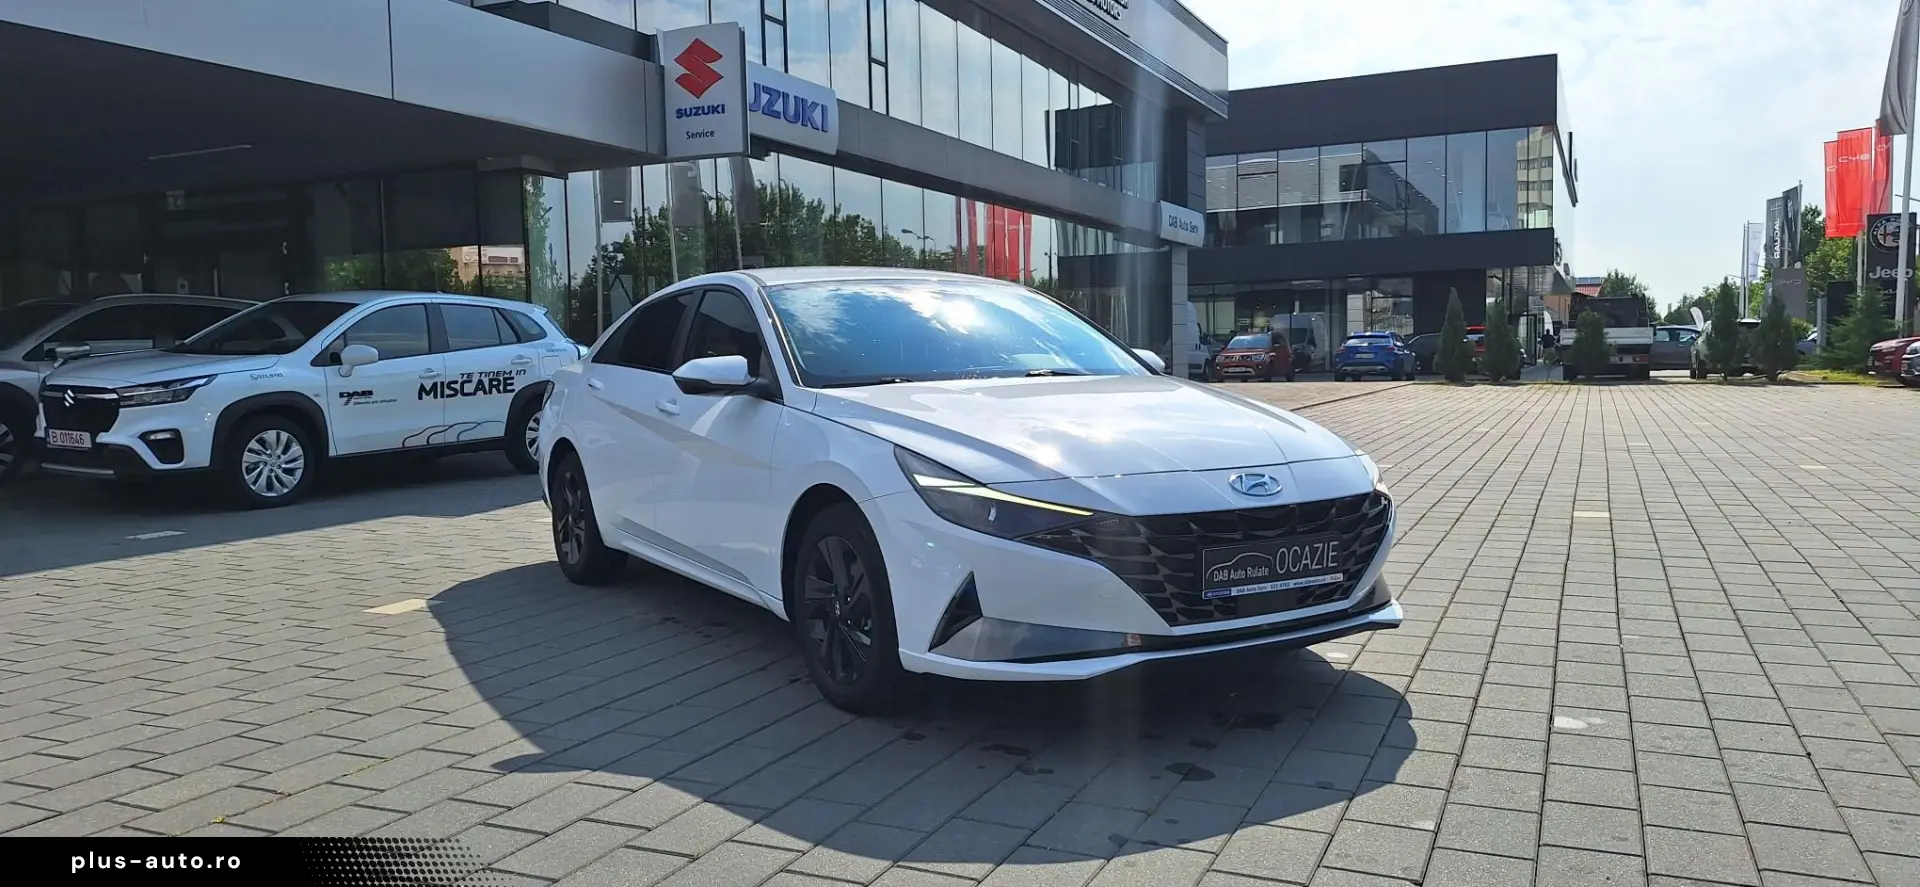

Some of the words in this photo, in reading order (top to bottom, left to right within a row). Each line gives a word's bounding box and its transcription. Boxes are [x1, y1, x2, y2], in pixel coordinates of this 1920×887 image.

[675, 103, 726, 119] SUZUKI
[748, 81, 829, 133] UZUKI
[686, 129, 715, 140] Service
[1168, 214, 1178, 229] DAB
[1179, 217, 1189, 232] Auto
[1868, 265, 1914, 279] Jeep
[459, 372, 475, 380] TE
[417, 376, 516, 401] MISCARE
[51, 431, 58, 443] B
[1276, 541, 1339, 574] OCAZIE
[1213, 570, 1229, 582] DAB
[1229, 568, 1245, 580] Auto
[1246, 566, 1269, 578] Rulate
